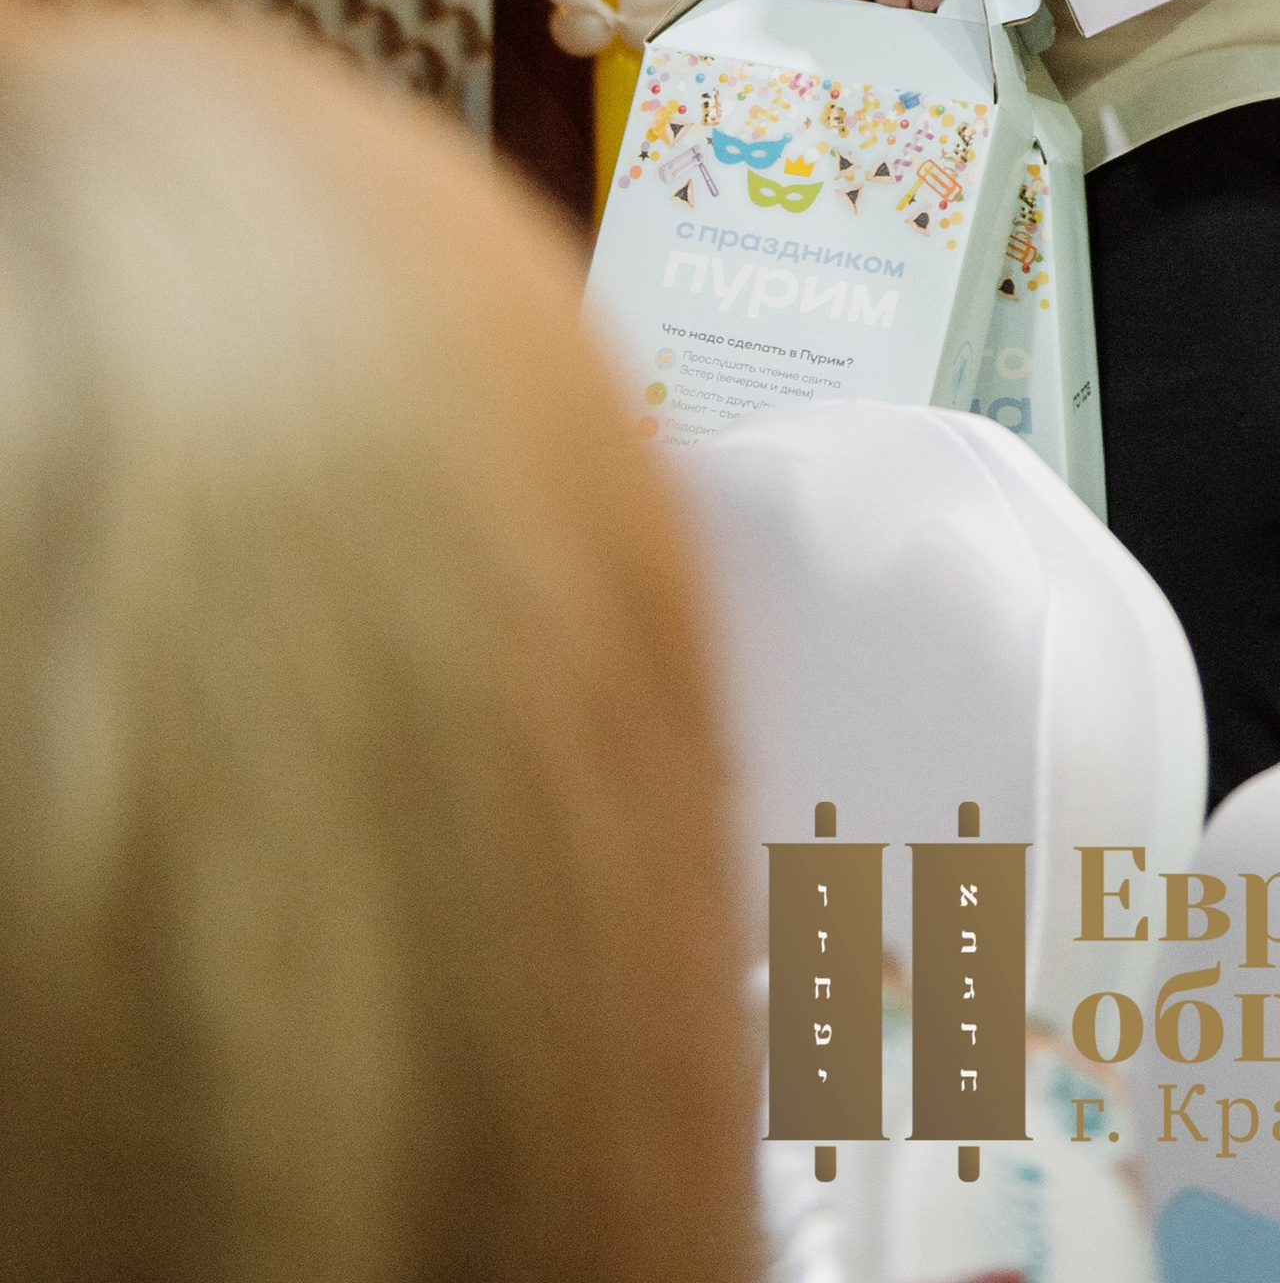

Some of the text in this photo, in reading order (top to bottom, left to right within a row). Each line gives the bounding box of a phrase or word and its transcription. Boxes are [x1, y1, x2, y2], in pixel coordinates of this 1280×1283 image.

[676, 221, 906, 278] с праздником
[662, 249, 900, 329] пурим
[662, 322, 855, 368] Что надо сделать в Пурим?
[679, 364, 714, 383] Эстер
[715, 371, 768, 391] (вечером
[779, 387, 815, 401] днем)
[682, 350, 842, 389] Прослушать чтение свитка
[674, 383, 724, 402] Послать
